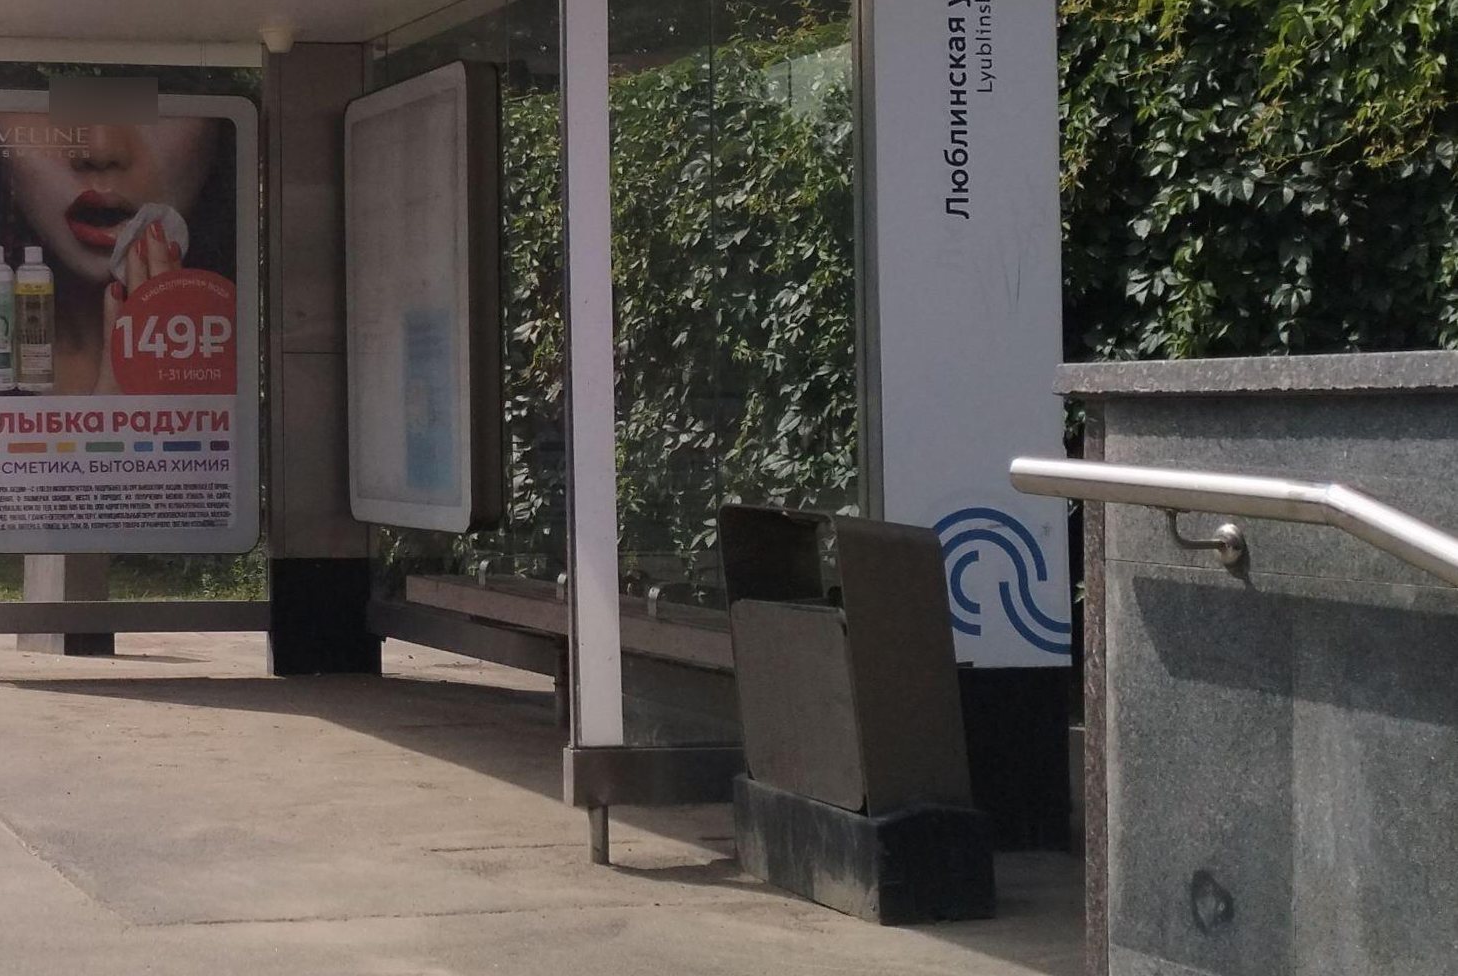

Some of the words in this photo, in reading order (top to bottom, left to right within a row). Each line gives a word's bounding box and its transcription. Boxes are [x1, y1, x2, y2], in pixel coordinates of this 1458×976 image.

[944, 16, 970, 220] Люблинская
[184, 368, 222, 381] ИЮЛЯ
[89, 459, 167, 474] БЫТОВАЯ
[171, 458, 230, 473] ХИМИЯ
